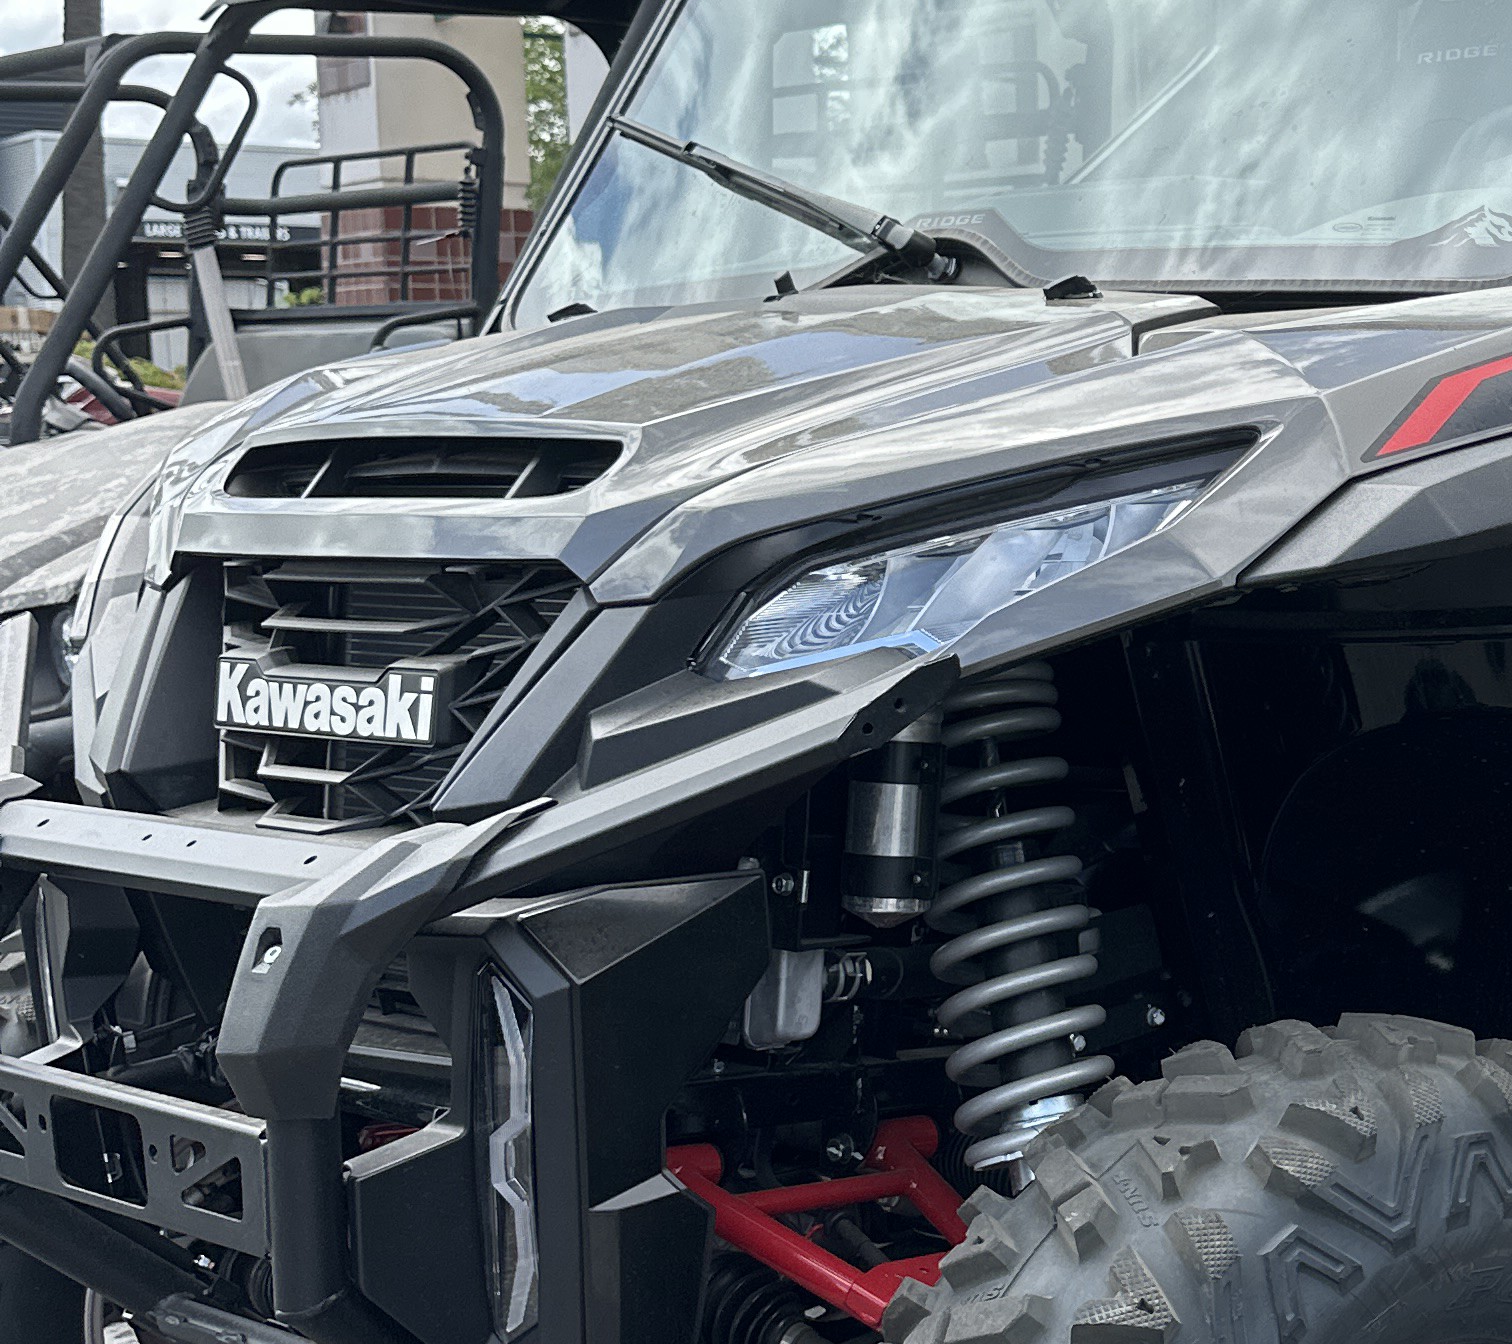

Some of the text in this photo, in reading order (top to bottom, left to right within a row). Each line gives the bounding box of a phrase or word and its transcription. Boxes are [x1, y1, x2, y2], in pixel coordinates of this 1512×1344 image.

[1416, 43, 1501, 65] RIDGE
[916, 213, 986, 229] RIDGE
[218, 661, 435, 742] Kawasaki
